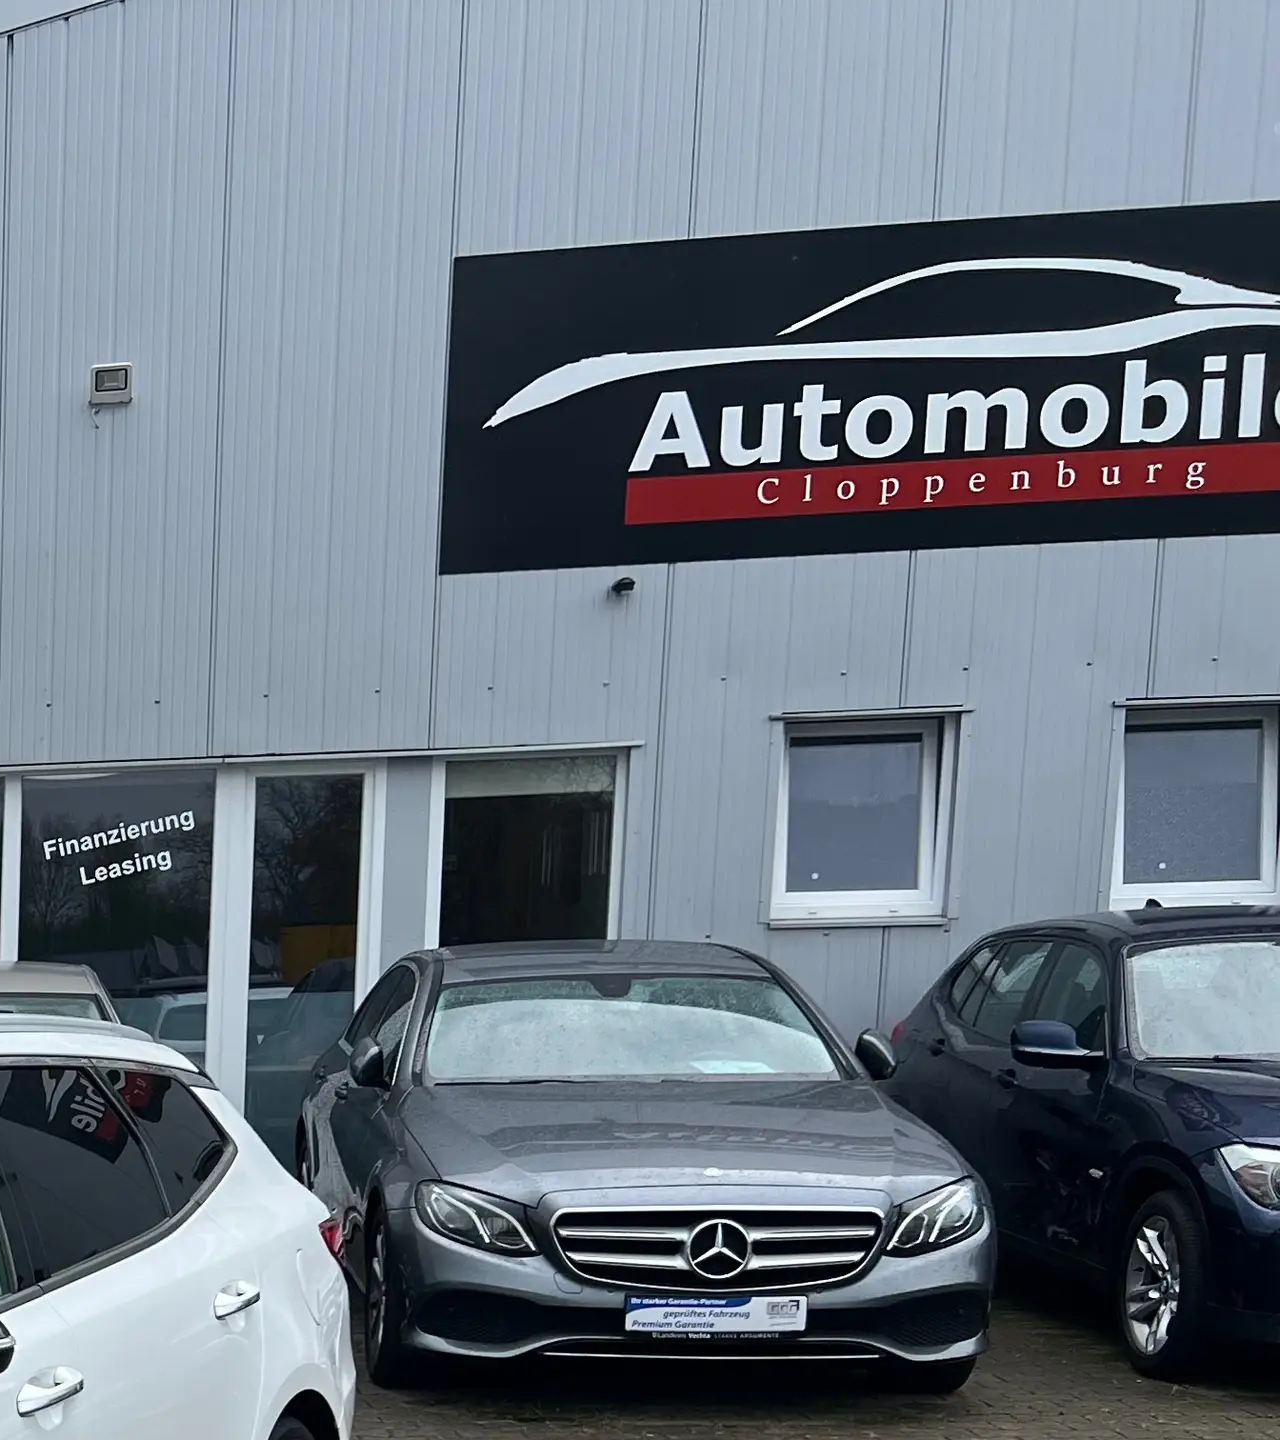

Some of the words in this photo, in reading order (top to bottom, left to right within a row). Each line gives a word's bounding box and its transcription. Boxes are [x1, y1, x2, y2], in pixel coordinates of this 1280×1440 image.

[627, 352, 1280, 472] Automobil
[756, 459, 1208, 506] Cloppenburg
[43, 809, 196, 861] Finanzierung
[79, 849, 172, 886] Leasing
[632, 1320, 672, 1328] Premium
[675, 1320, 715, 1328] Garantie
[663, 1310, 706, 1319] geprüftes
[708, 1310, 750, 1319] Fahrzeug
